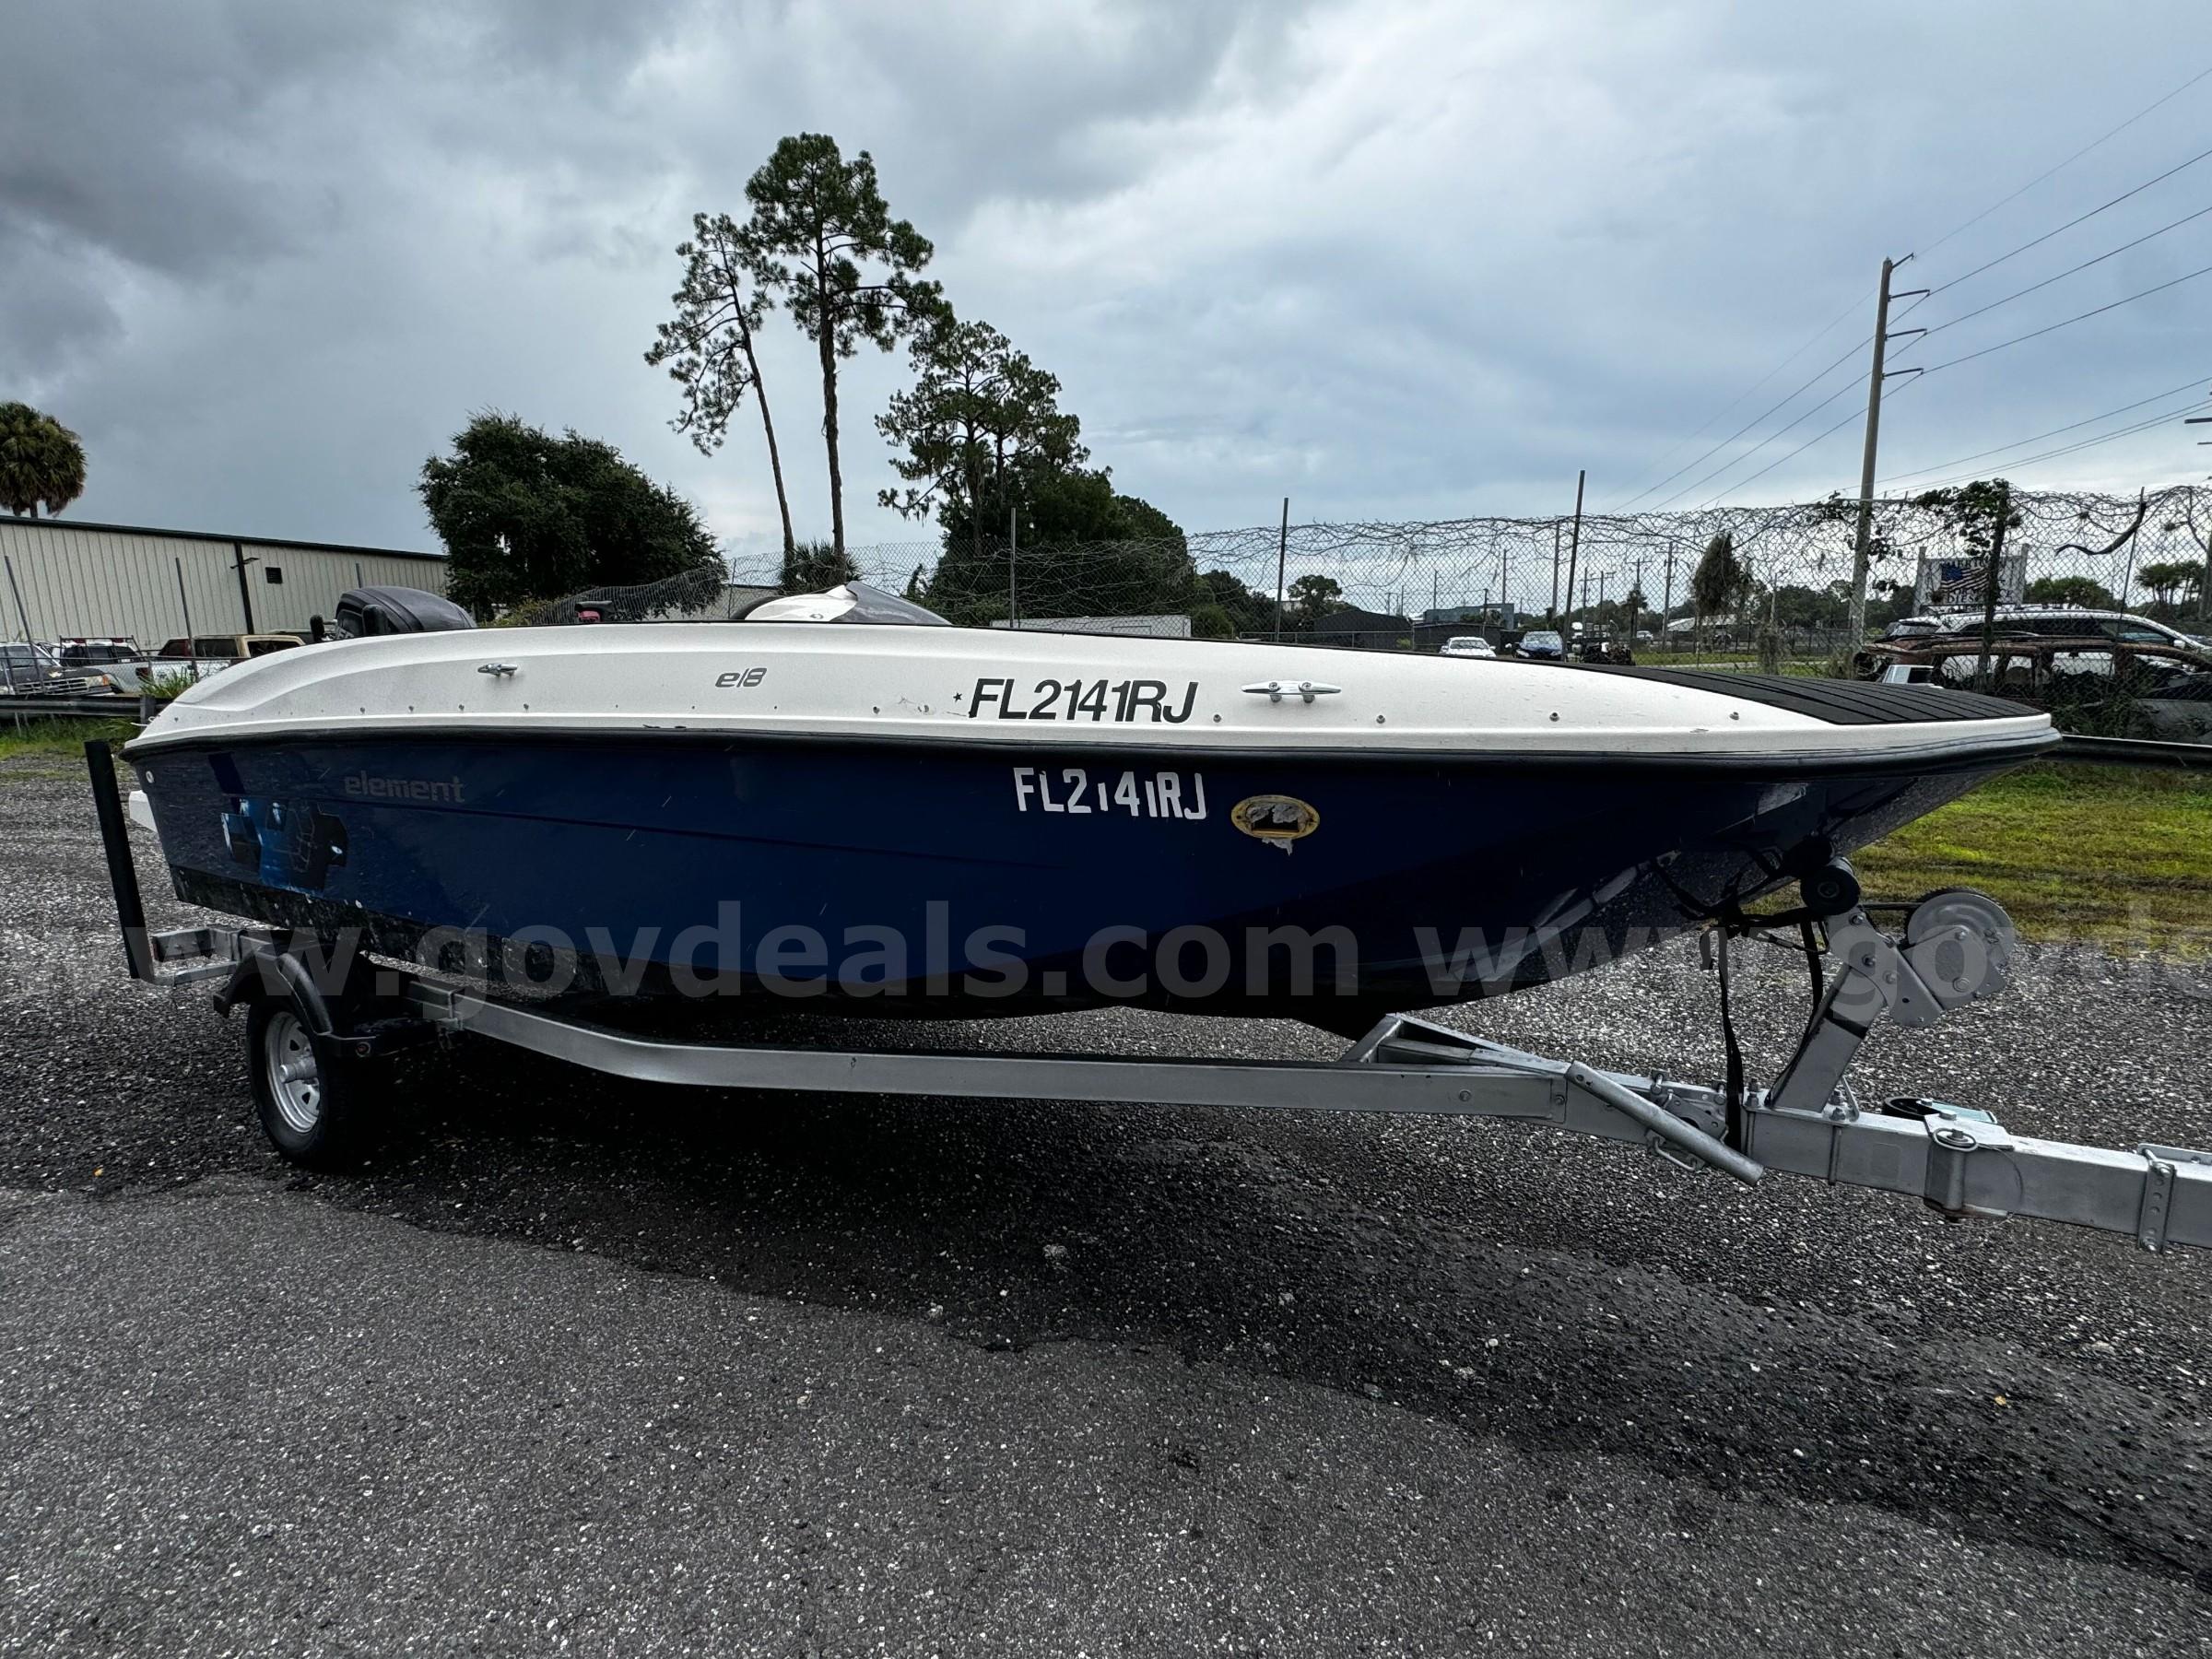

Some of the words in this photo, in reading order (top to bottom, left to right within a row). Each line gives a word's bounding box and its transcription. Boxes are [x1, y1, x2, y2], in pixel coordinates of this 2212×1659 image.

[968, 677, 1199, 724] FL2141RJ
[344, 770, 465, 803] element
[1013, 767, 1207, 819] FL2141RJ
